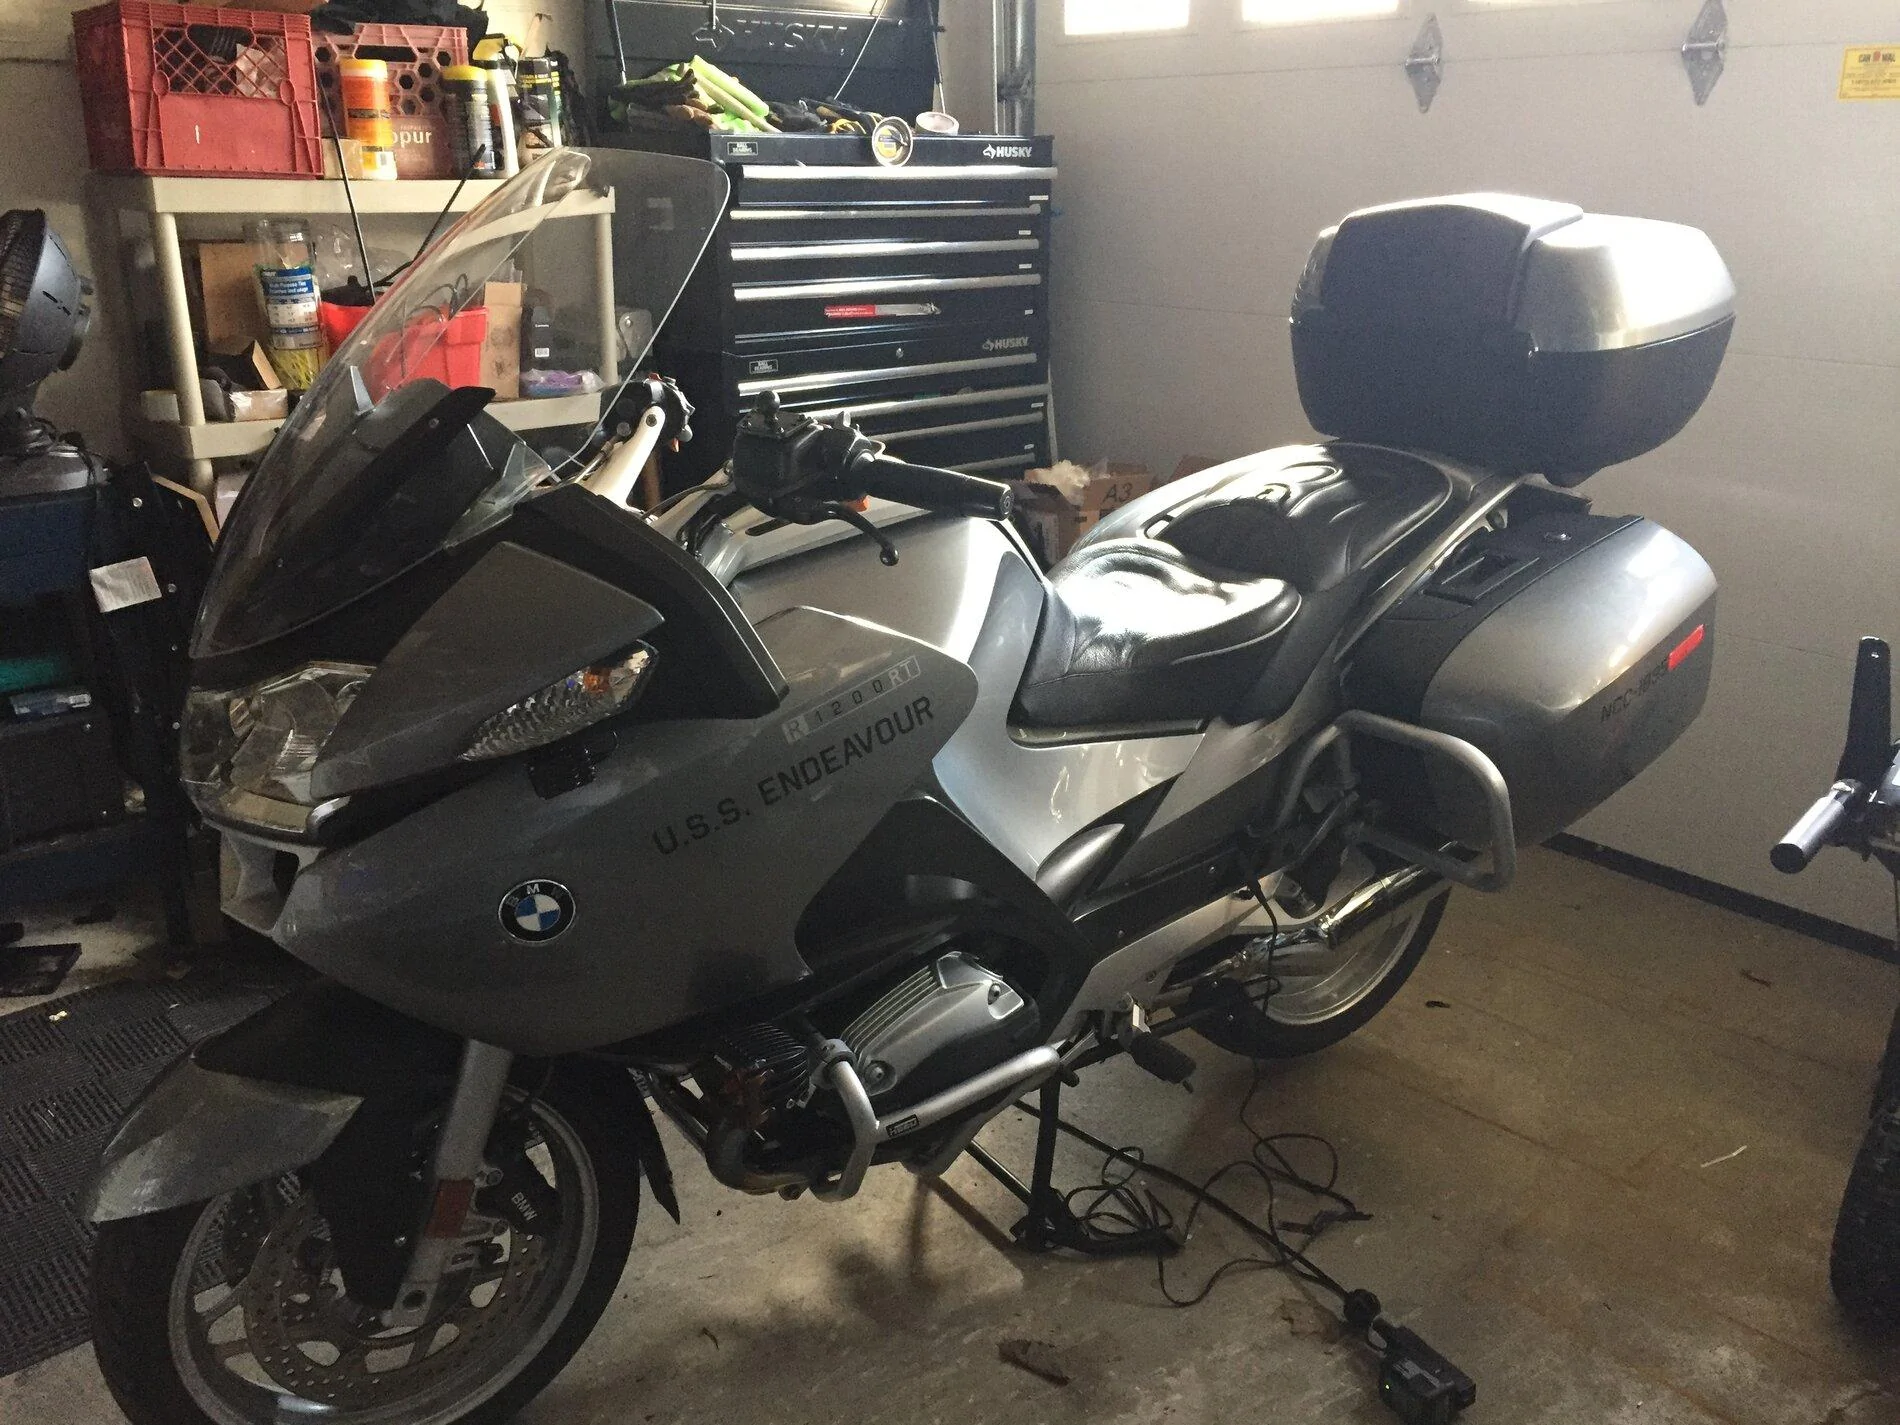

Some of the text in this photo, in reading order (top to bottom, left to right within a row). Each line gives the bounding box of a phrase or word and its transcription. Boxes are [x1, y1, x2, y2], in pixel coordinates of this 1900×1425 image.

[996, 146, 1032, 158] HUSKY
[995, 336, 1030, 350] HUSKY
[1102, 483, 1133, 503] A3
[652, 695, 935, 856] U.S.S. ENDEAVOUR
[511, 1191, 538, 1221] BMW
